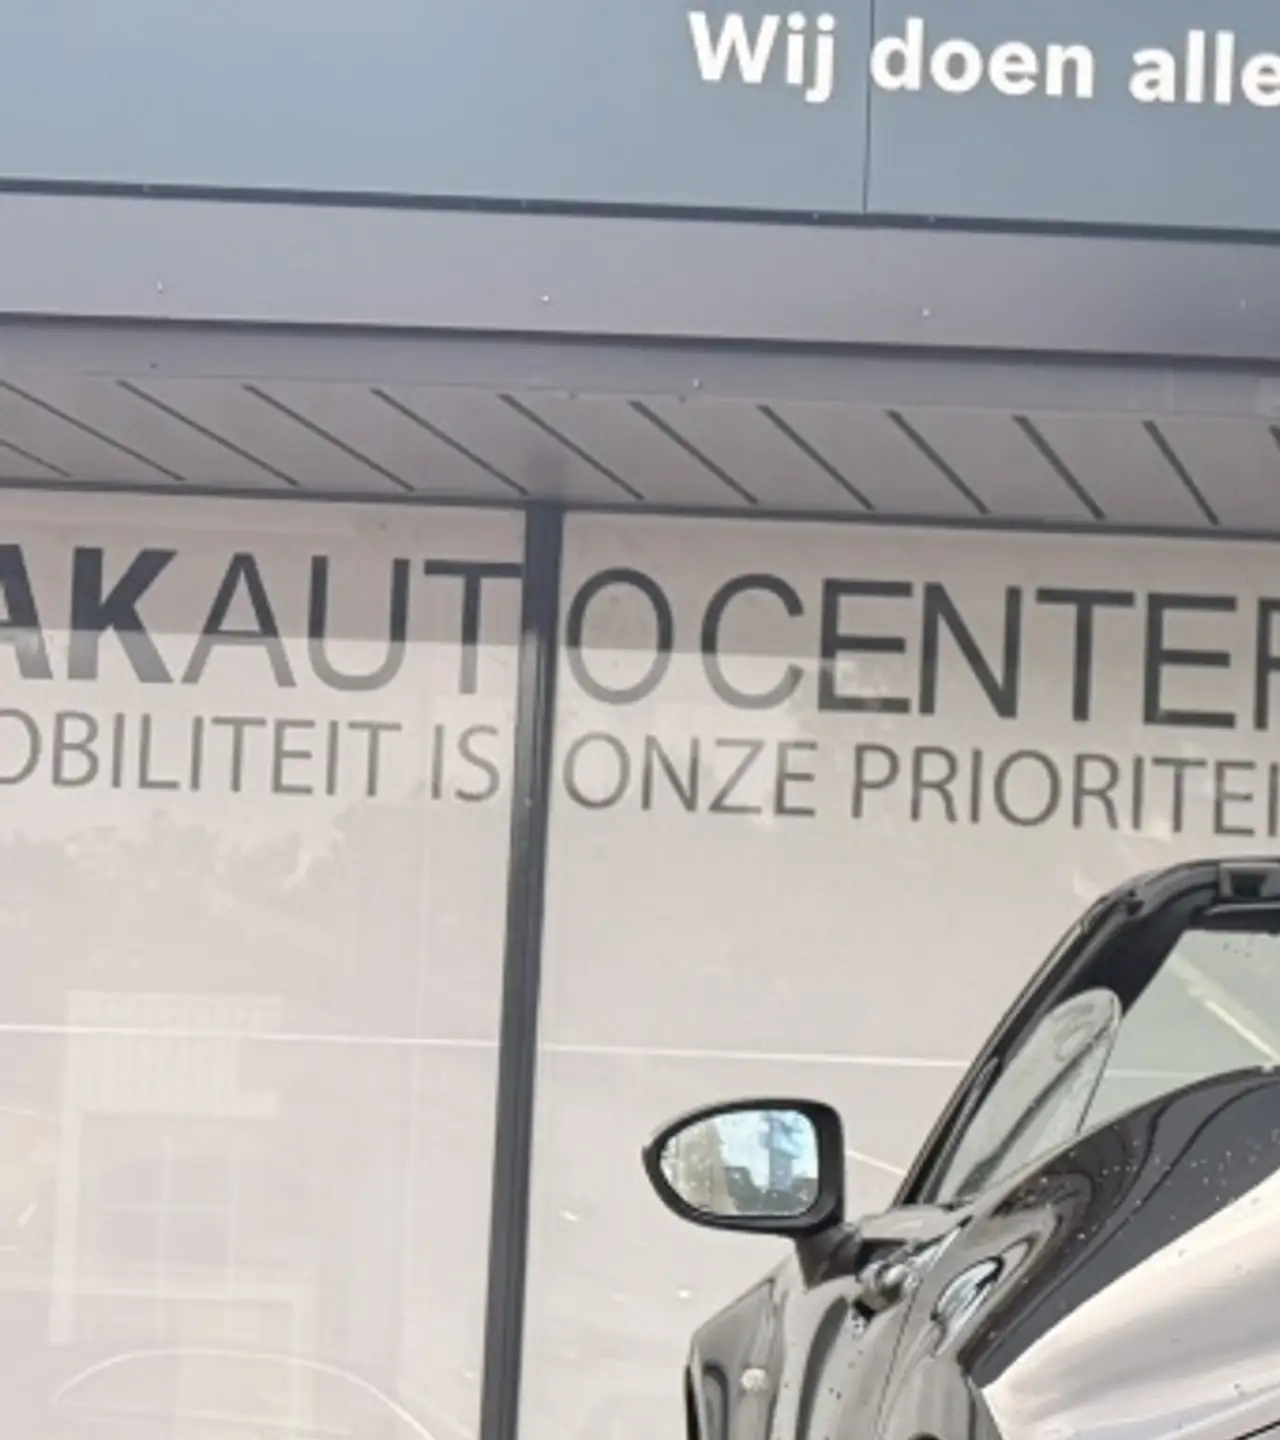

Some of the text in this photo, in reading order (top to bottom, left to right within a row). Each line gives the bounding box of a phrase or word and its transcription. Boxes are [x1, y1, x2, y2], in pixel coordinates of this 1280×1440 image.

[688, 12, 834, 103] Wij
[870, 18, 1094, 98] doen
[430, 723, 501, 802] IS
[562, 731, 818, 819] ONZE
